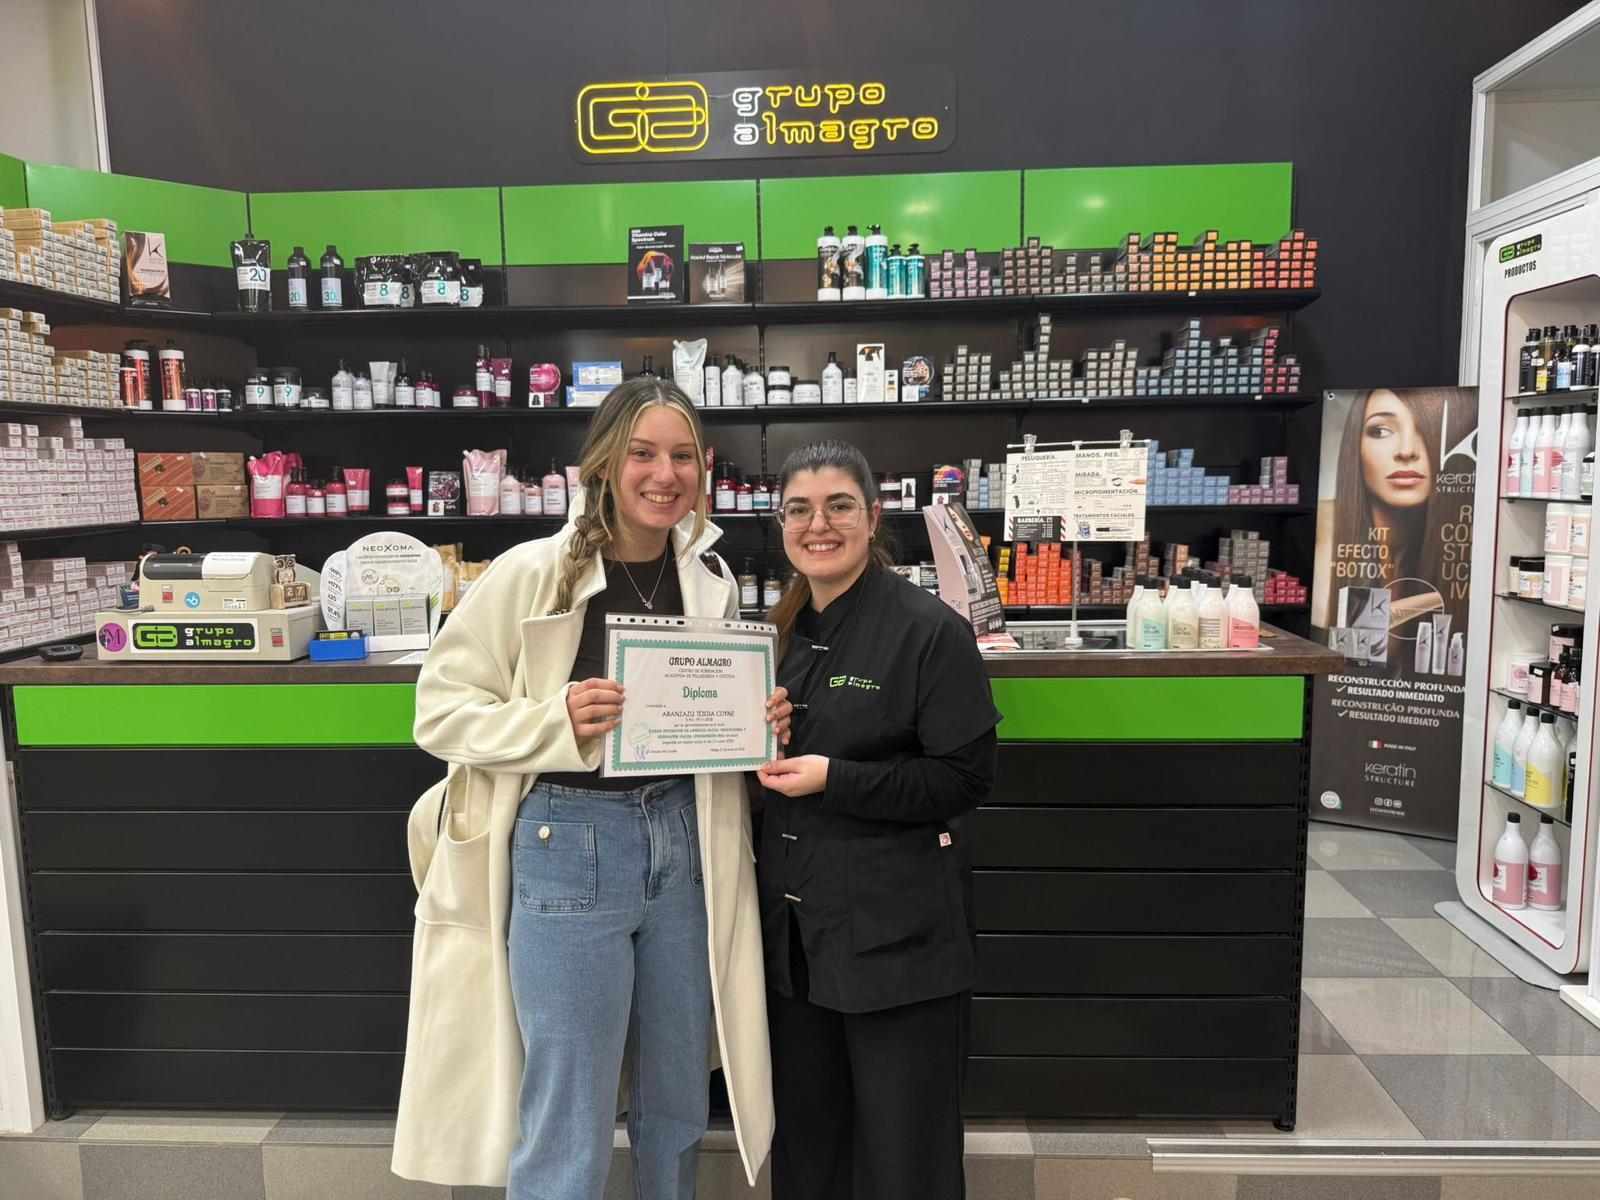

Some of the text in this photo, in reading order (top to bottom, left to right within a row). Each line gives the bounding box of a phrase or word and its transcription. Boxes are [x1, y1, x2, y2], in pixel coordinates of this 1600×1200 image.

[733, 83, 886, 116] grupo
[733, 112, 939, 150] almagro
[249, 267, 267, 282] 20
[1504, 260, 1537, 279] PRODUCTOS
[379, 284, 389, 297] 8
[401, 286, 410, 299] 8
[437, 282, 446, 295] 8
[460, 288, 469, 301] 8
[290, 292, 300, 302] 20
[324, 291, 336, 301] 30
[257, 386, 264, 398] 9
[284, 386, 292, 397] 9
[1368, 527, 1390, 541] KIT
[362, 543, 414, 553] NEOXOMA
[1337, 543, 1389, 560] EFECTO
[185, 627, 235, 638] grupo
[185, 636, 253, 649] almagro
[668, 656, 732, 667] GRUPO ALMAGRO
[1327, 674, 1465, 694] RECONSTRUCCIÓN PROFUNDA
[682, 685, 718, 700] Diploma
[1347, 686, 1445, 703] RESULTADO INMEDIATO
[1331, 698, 1460, 719] RECONSTRUÇÃO PROFUNDA
[1349, 710, 1440, 727] RESULTADO IMEDIATO
[1364, 762, 1417, 779] keratin
[1364, 775, 1416, 787] STRUCTURE
